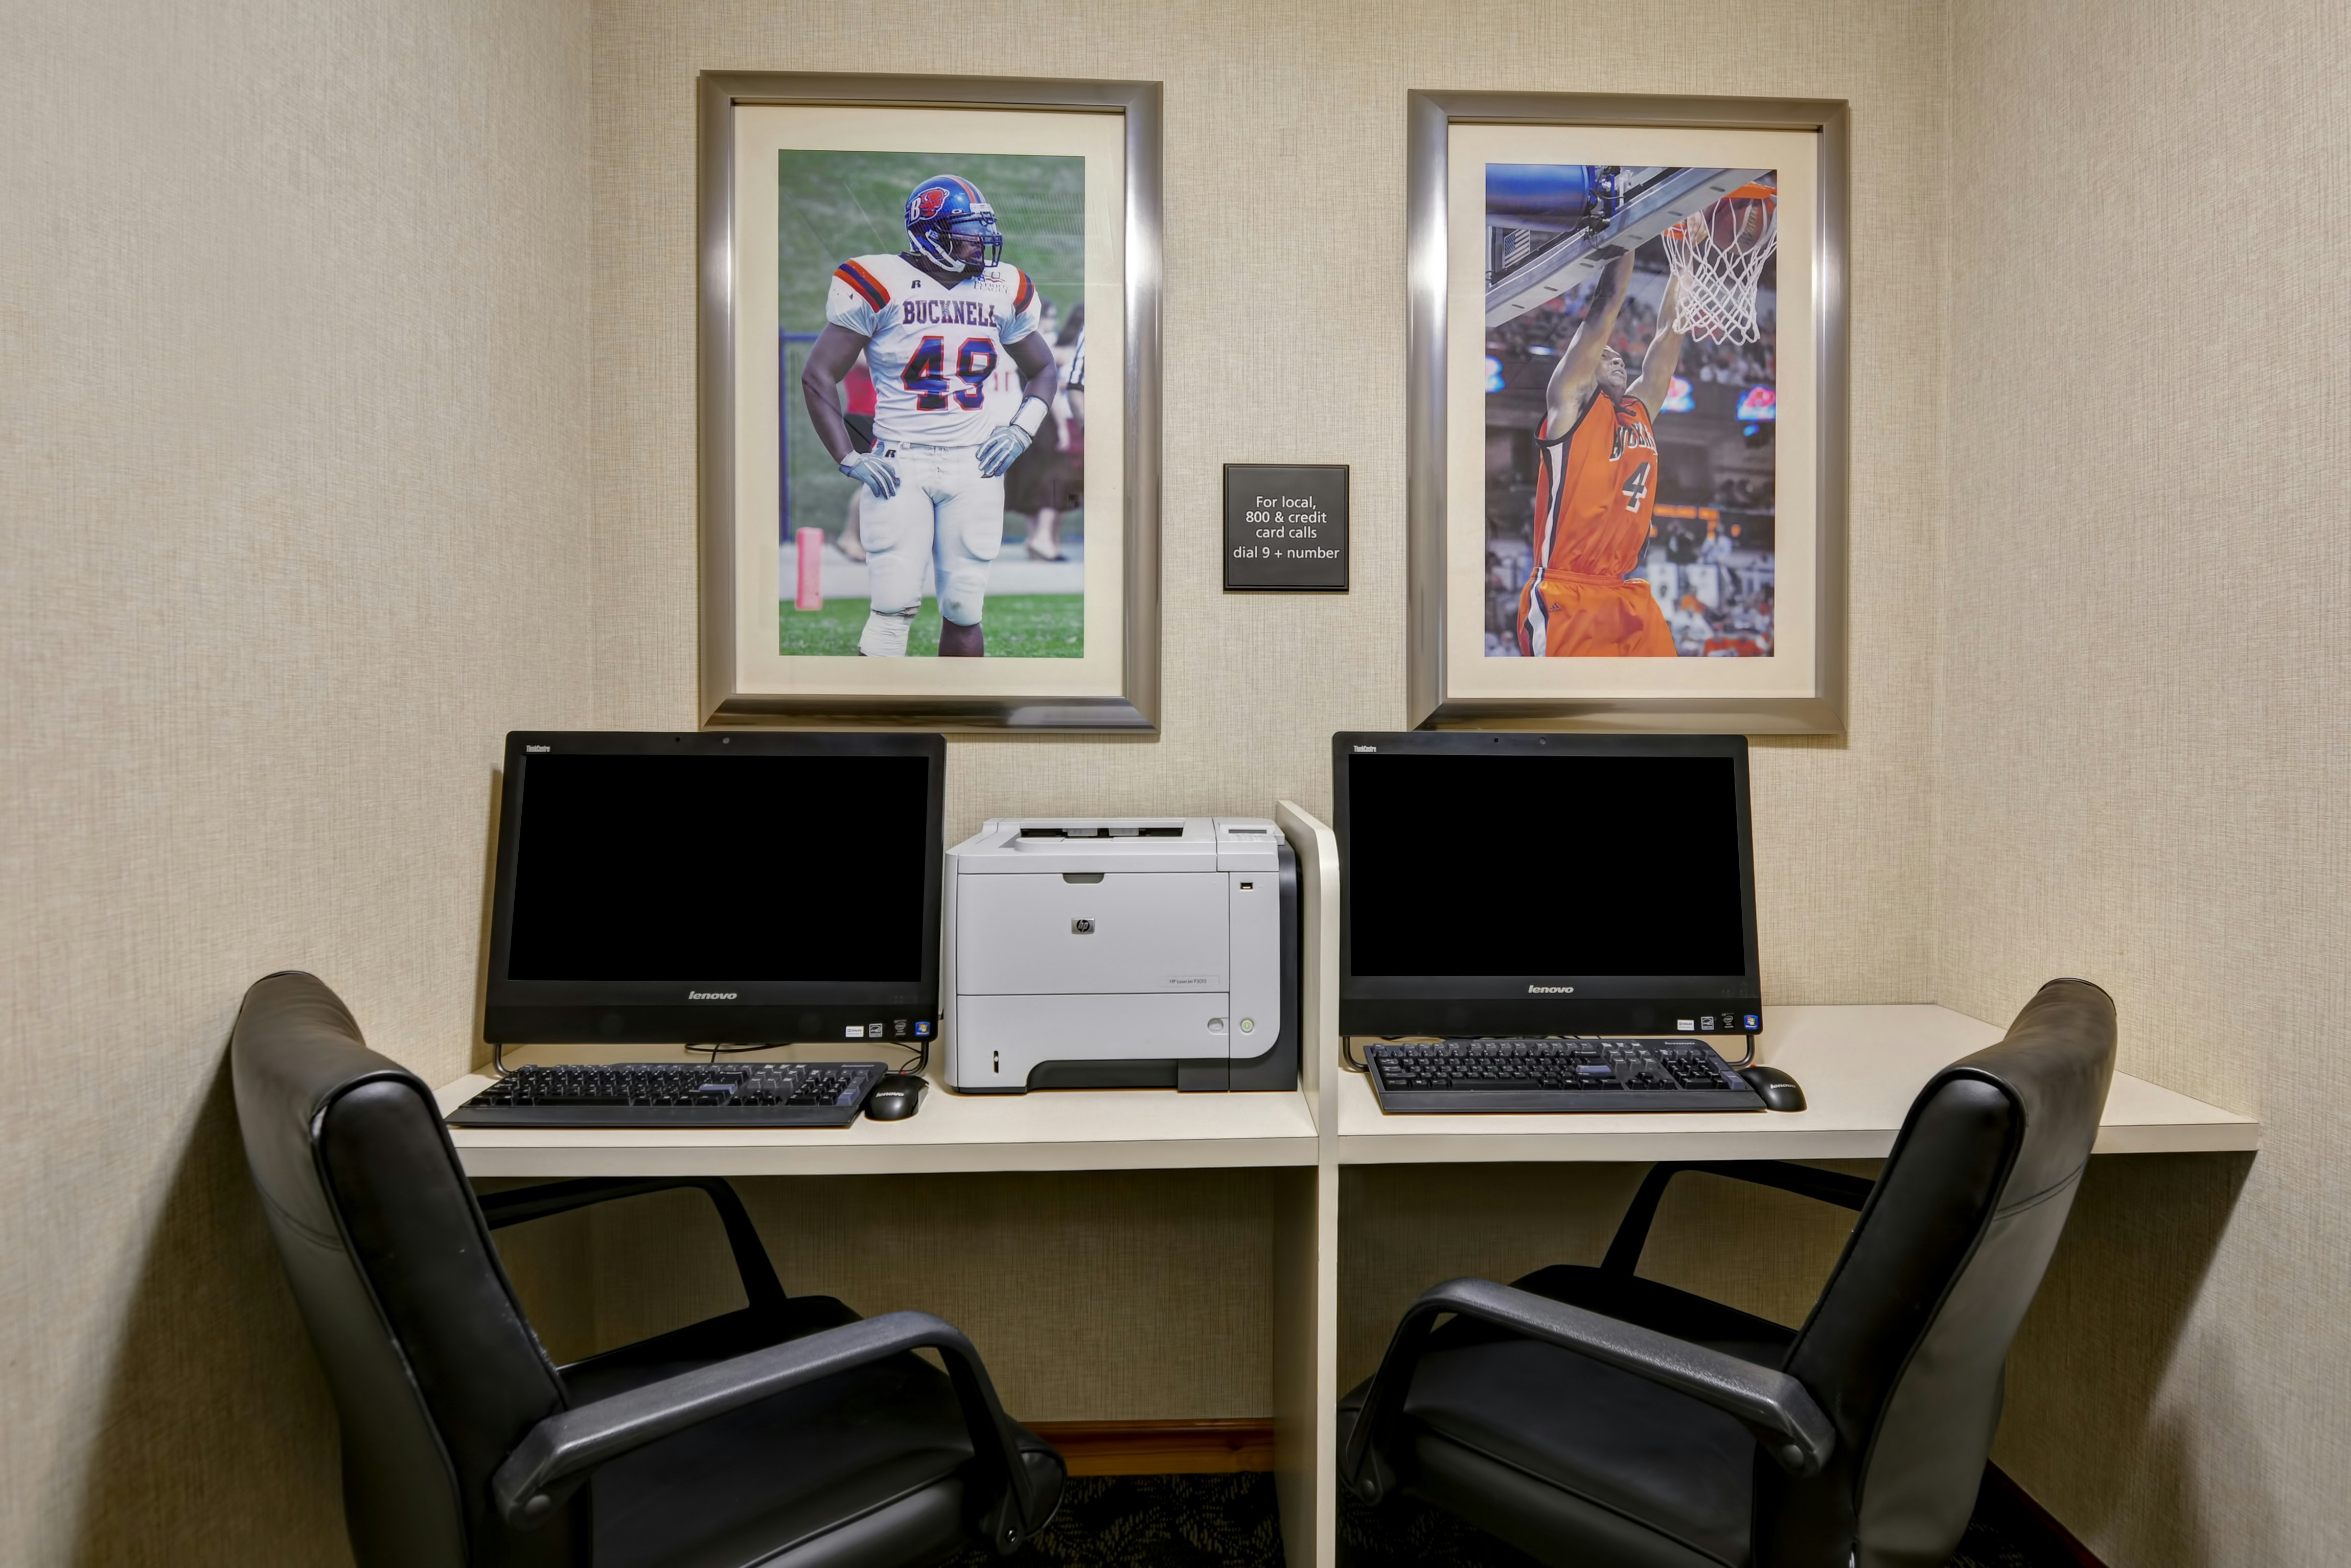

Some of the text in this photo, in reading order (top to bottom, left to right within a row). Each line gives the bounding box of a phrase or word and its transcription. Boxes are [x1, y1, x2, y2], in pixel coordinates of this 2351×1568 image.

[903, 300, 997, 327] BUCKNELL
[900, 335, 998, 411] 49
[1622, 462, 1651, 513] 4
[1256, 495, 1316, 510] For local,
[1246, 511, 1327, 523] 800 & credit
[1256, 526, 1317, 538] card calls
[1233, 546, 1340, 558] dial 9 + number
[1077, 919, 1089, 932] hp
[688, 990, 737, 1000] lenovo
[1528, 984, 1574, 994] lenovo
